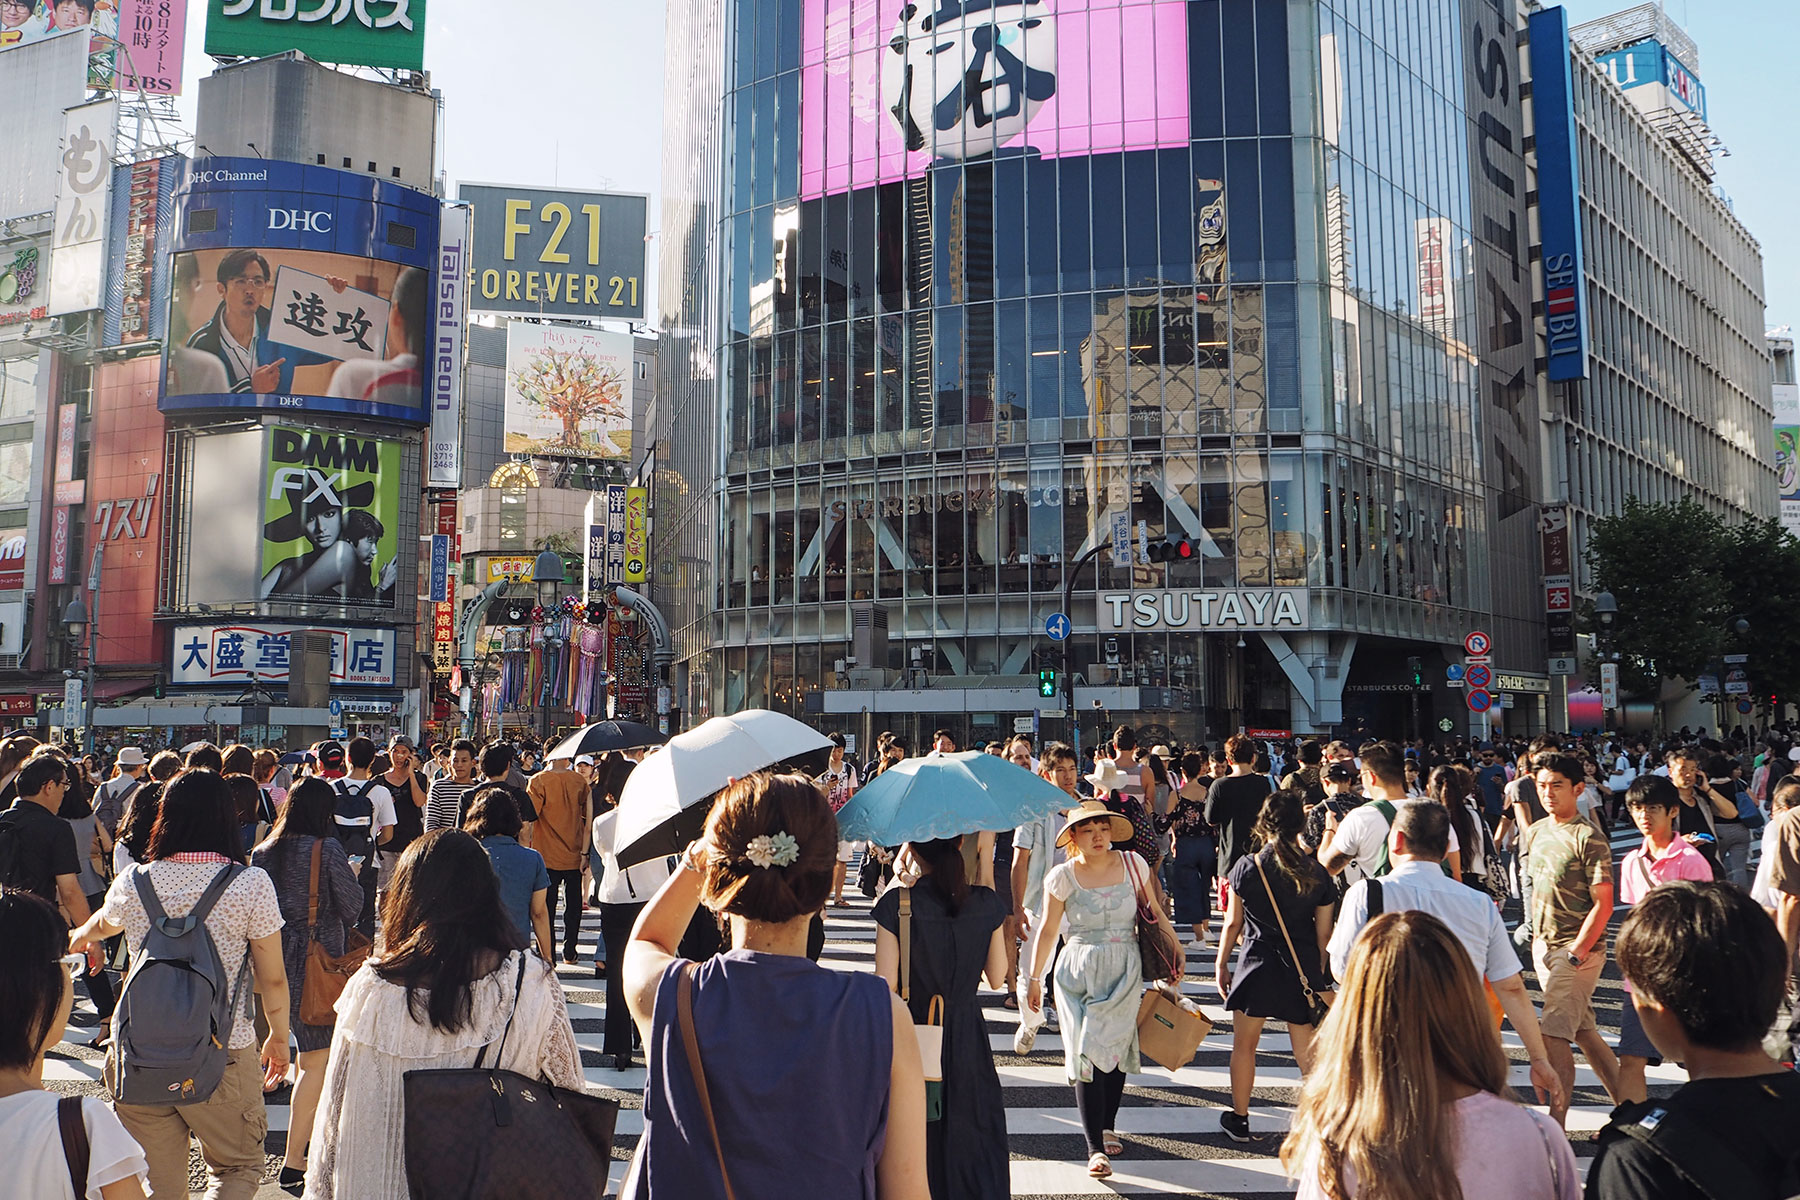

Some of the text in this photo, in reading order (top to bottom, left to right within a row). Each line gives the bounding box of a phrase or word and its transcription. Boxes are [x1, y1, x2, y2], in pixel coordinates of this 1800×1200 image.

[127, 76, 172, 91] TBS
[187, 170, 267, 183] DHC Channel
[268, 208, 332, 233] DHC
[504, 199, 600, 265] F21
[608, 276, 638, 307] 21
[1545, 252, 1578, 358] SEIBU
[283, 290, 374, 352] 速攻
[437, 239, 461, 411] Taisei neon
[542, 329, 565, 345] This
[569, 335, 577, 344] is
[279, 396, 303, 407] DHC
[272, 428, 380, 474] DMM
[433, 452, 454, 460] 3719
[435, 443, 453, 451] (03)
[541, 446, 560, 454] NOW
[269, 467, 342, 506] FX
[830, 482, 1143, 523] STARBUCKS COFEE
[52, 510, 66, 579] もんじゃ焼
[608, 490, 626, 583] 洋服の青山
[1118, 515, 1129, 562] 渋谷駅前
[434, 538, 446, 598] 大盛堂商事ビル
[628, 562, 641, 572] 4F
[1105, 593, 1302, 627] TSUTAYA
[1550, 590, 1567, 607] 本
[436, 642, 451, 668] 牛繁
